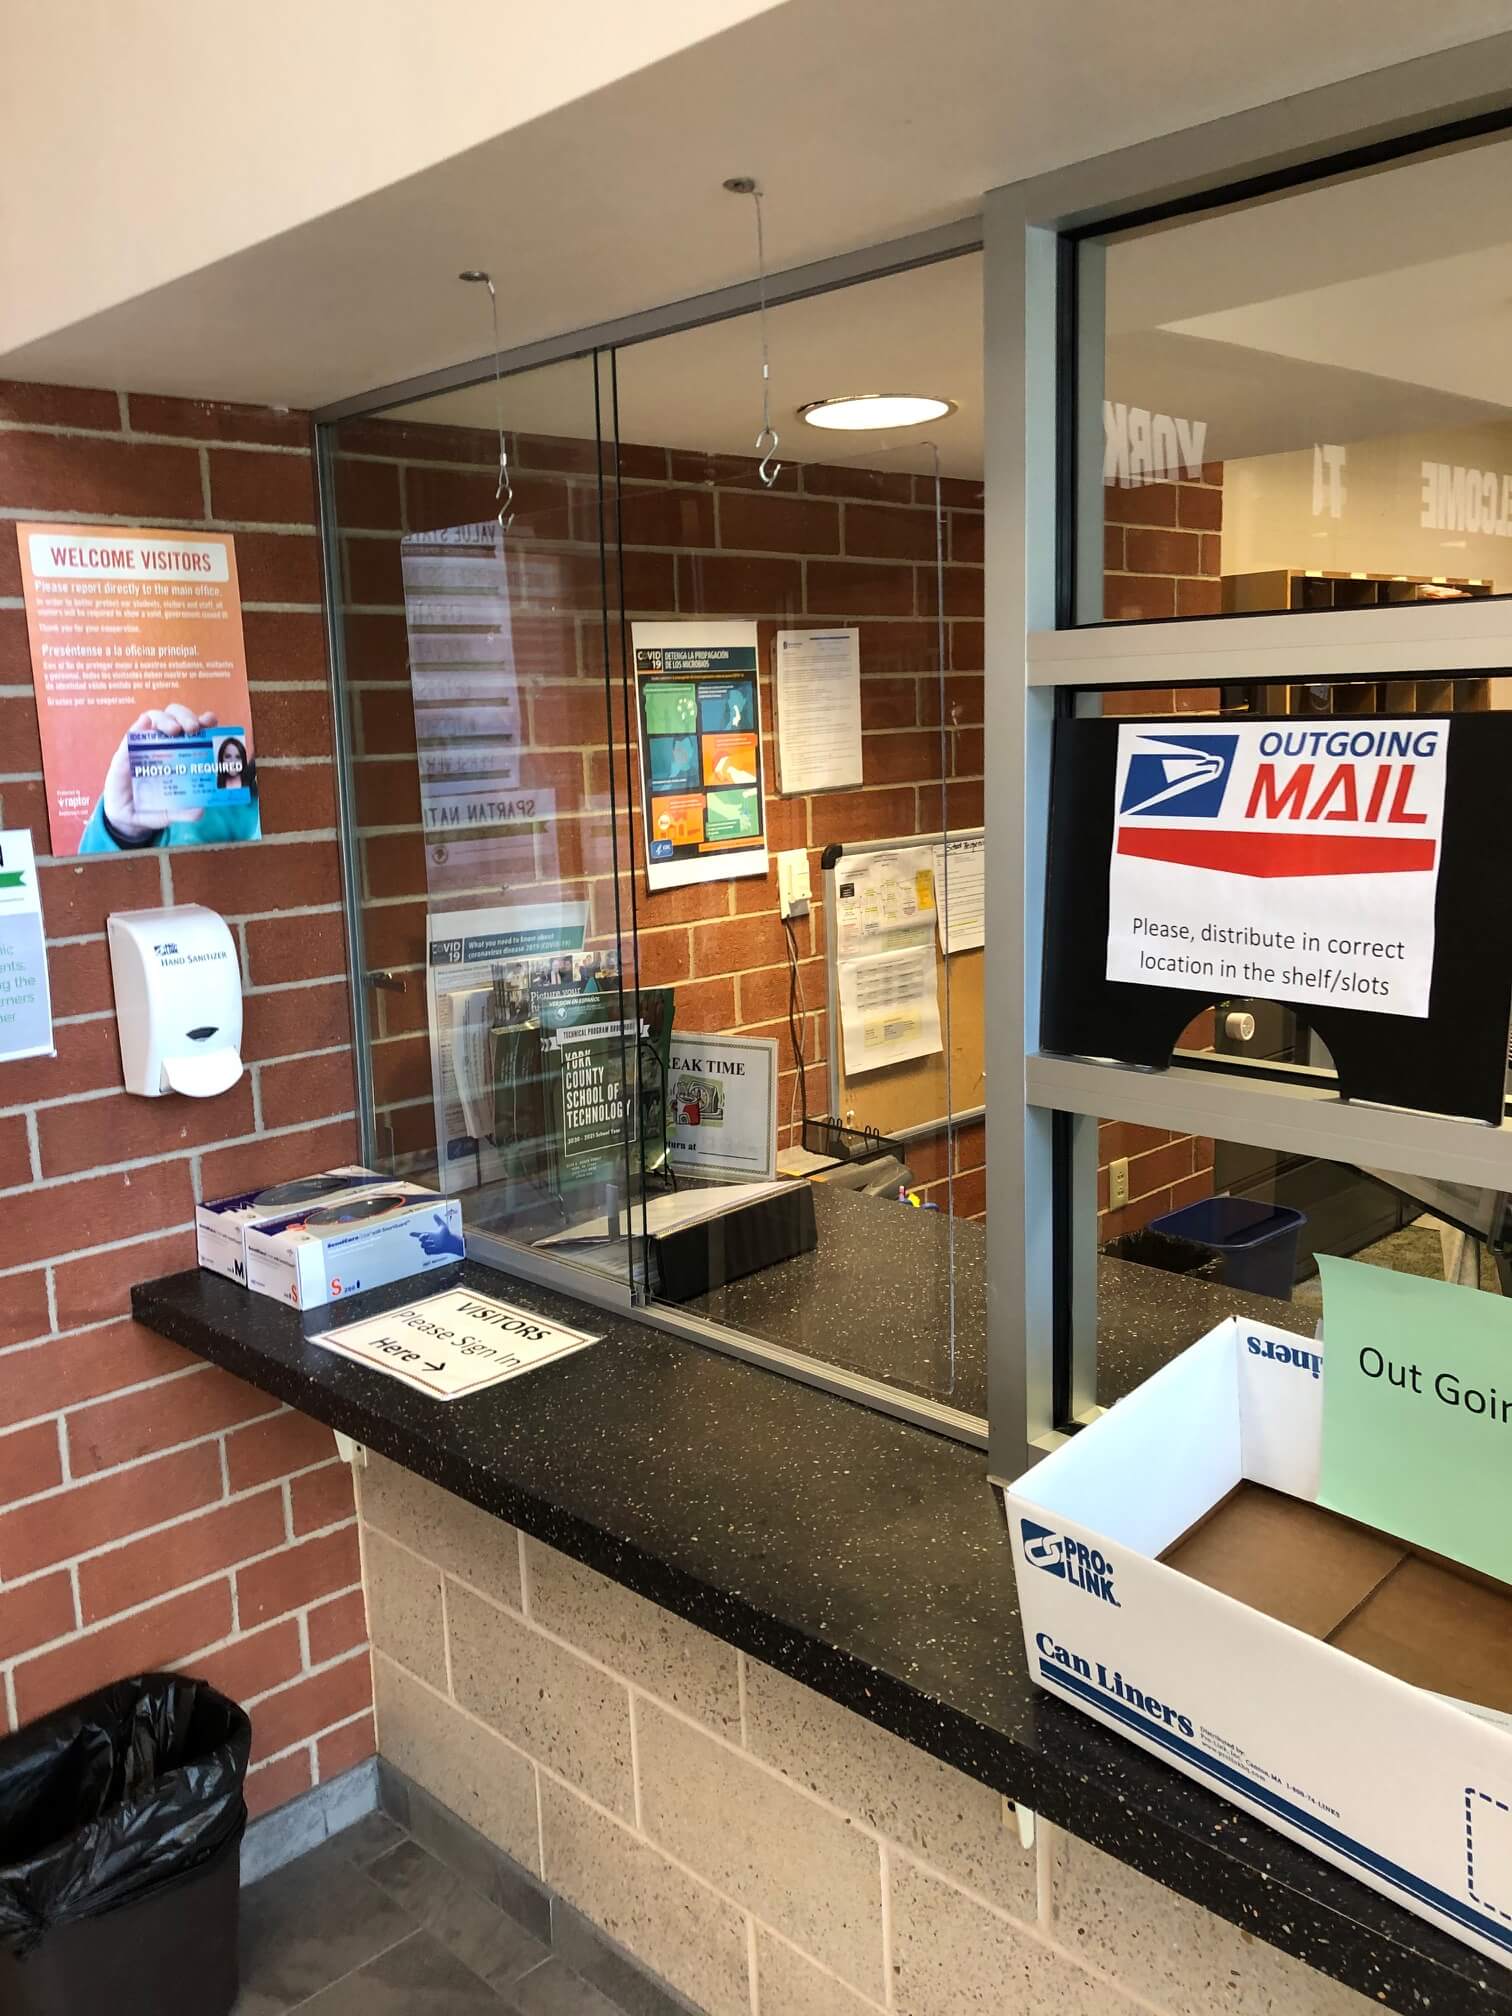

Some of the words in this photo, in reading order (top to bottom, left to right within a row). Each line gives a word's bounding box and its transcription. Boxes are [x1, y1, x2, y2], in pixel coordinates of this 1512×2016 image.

[50, 547, 135, 569] WELCOME
[141, 550, 211, 573] VISITORS
[35, 581, 68, 594] Please
[71, 583, 101, 596] report
[104, 583, 139, 597] directly
[142, 584, 152, 595] to
[154, 583, 169, 595] the
[171, 585, 193, 596] main
[105, 647, 111, 655] a
[113, 644, 123, 655] la
[125, 644, 156, 656] oficina
[665, 660, 673, 669] DE
[673, 660, 682, 669] LOS
[1258, 731, 1438, 757] OUTGOING
[134, 765, 172, 778] PHOTO
[175, 766, 187, 776] ID
[190, 761, 243, 774] REQUIRED
[1244, 763, 1428, 824] MAIL
[1133, 917, 1195, 943] Please,
[1201, 923, 1295, 950] distribute
[1302, 932, 1321, 952] in
[1327, 938, 1405, 960] correct
[448, 951, 461, 963] 19
[14, 975, 38, 987] the
[1139, 950, 1213, 977] location
[1220, 958, 1237, 978] in
[1243, 961, 1275, 983] the
[1281, 966, 1390, 997] shelf/slots
[565, 1066, 604, 1089] COUNTY
[668, 1057, 703, 1072] EAK
[706, 1060, 746, 1076] TIME
[566, 1086, 603, 1109] SCHOOL
[607, 1083, 619, 1100] OF
[688, 1142, 696, 1151] at
[234, 1259, 244, 1280] M
[291, 1283, 299, 1303] S
[331, 1277, 343, 1296] S
[457, 1301, 552, 1342] VISITORS
[368, 1335, 421, 1363] Here
[393, 1310, 455, 1341] Please
[451, 1334, 498, 1361] Sign
[495, 1351, 522, 1369] In
[1246, 1335, 1323, 1380] iners
[1359, 1346, 1422, 1394] Out
[1065, 1560, 1122, 1608] LINK
[1035, 1632, 1092, 1680] Can
[1095, 1661, 1195, 1738] Liners
[1271, 1772, 1282, 1785] MA
